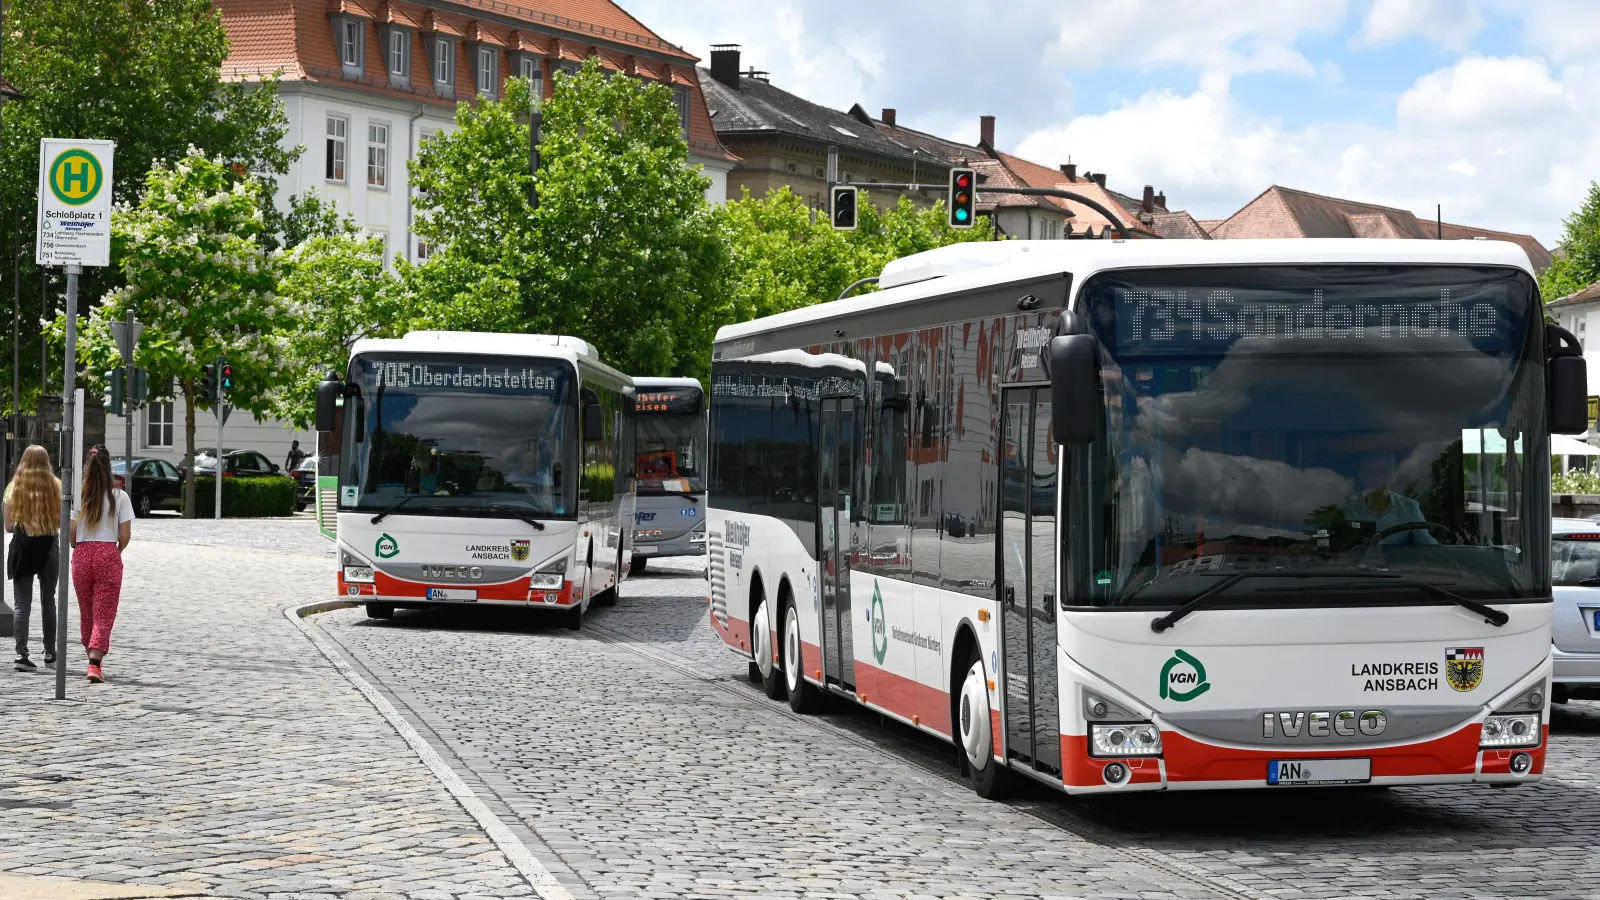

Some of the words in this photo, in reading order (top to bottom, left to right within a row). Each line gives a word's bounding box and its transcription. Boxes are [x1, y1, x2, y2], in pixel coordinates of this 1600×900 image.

[64, 162, 88, 192] H
[46, 210, 95, 220] Schloßplatz
[1124, 290, 1201, 340] 734
[1206, 288, 1497, 340] Sondernohe
[372, 361, 410, 388] 705
[412, 364, 554, 390] Oberdachstetten
[422, 566, 484, 579] IVECO
[432, 590, 443, 598] AN
[1352, 662, 1438, 676] LANDKREIS
[1170, 673, 1196, 683] VGN
[1364, 678, 1438, 691] ANSBACH
[1263, 710, 1387, 738] IVECO
[1279, 763, 1301, 779] AN
